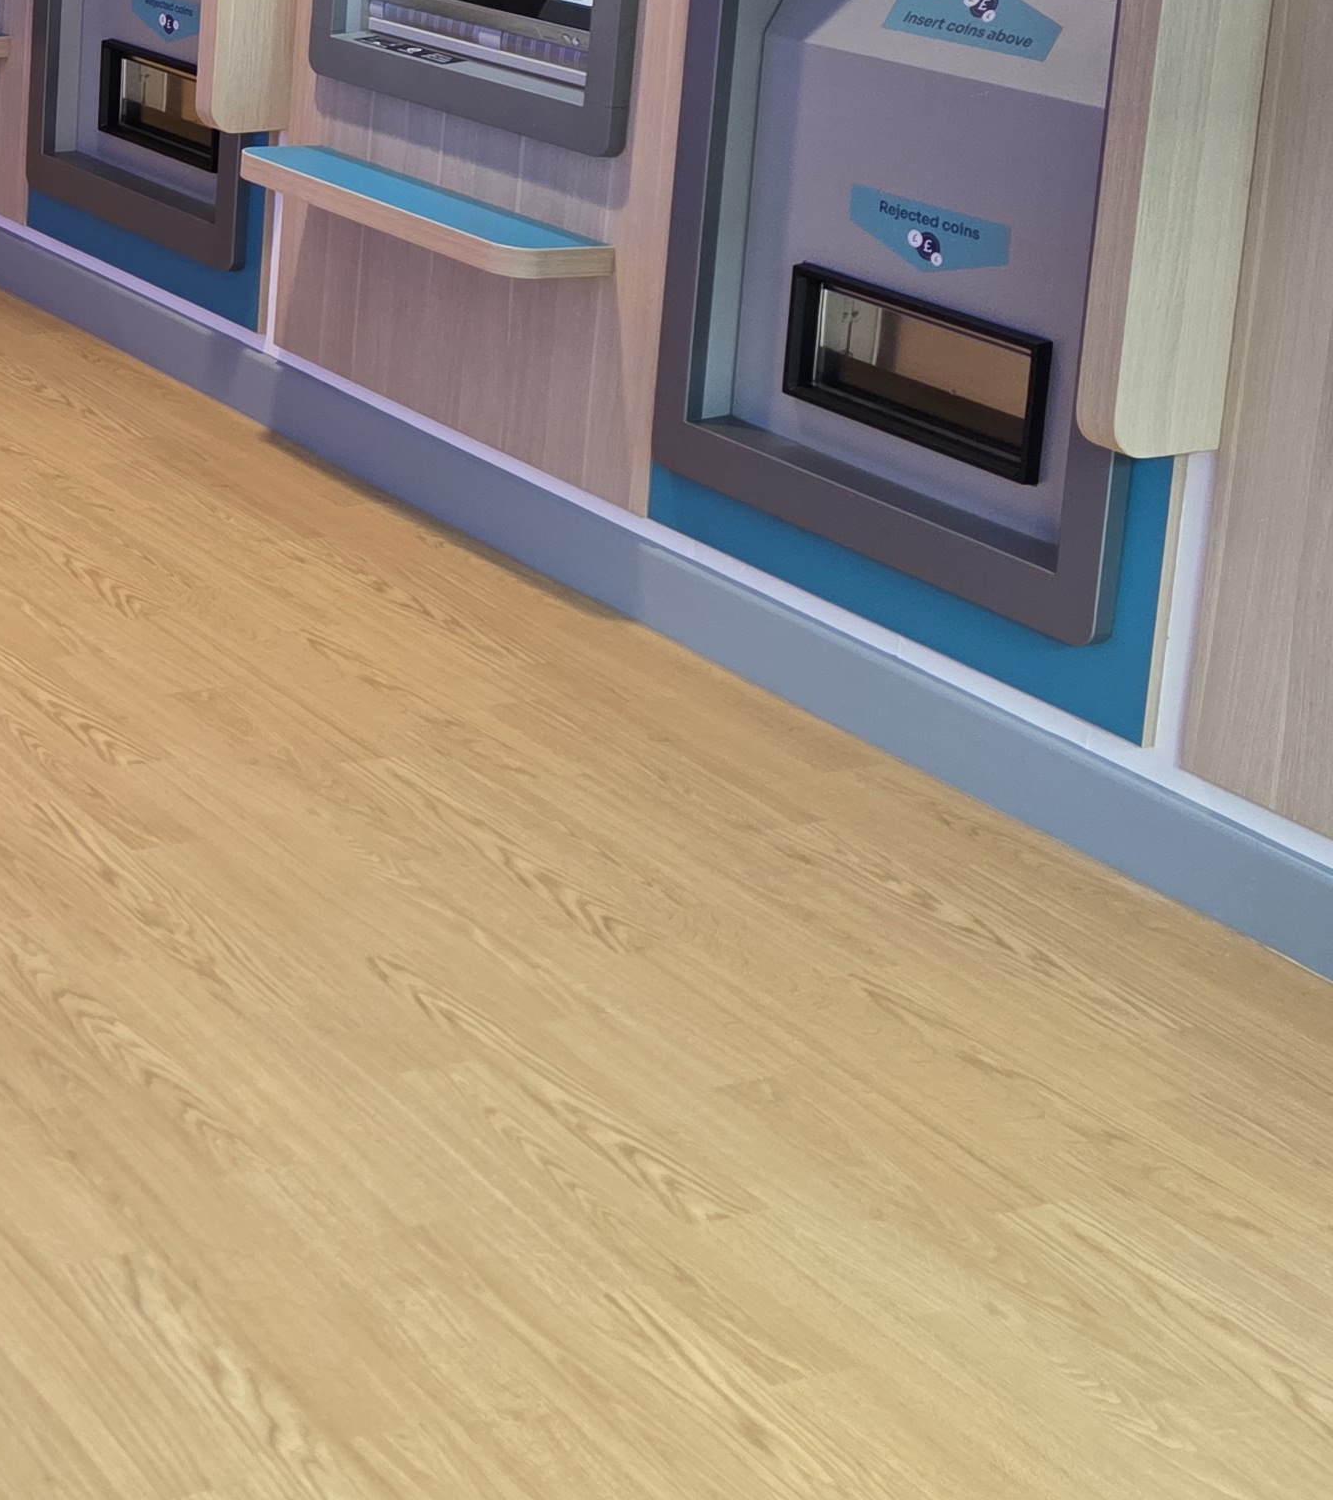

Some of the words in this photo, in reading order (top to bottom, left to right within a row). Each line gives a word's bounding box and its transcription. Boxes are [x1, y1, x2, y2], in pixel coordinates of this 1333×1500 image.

[903, 11, 945, 30] Insert
[946, 22, 985, 39] coins
[987, 29, 1033, 48] above
[879, 199, 939, 228] Rejected
[942, 220, 980, 240] coins
